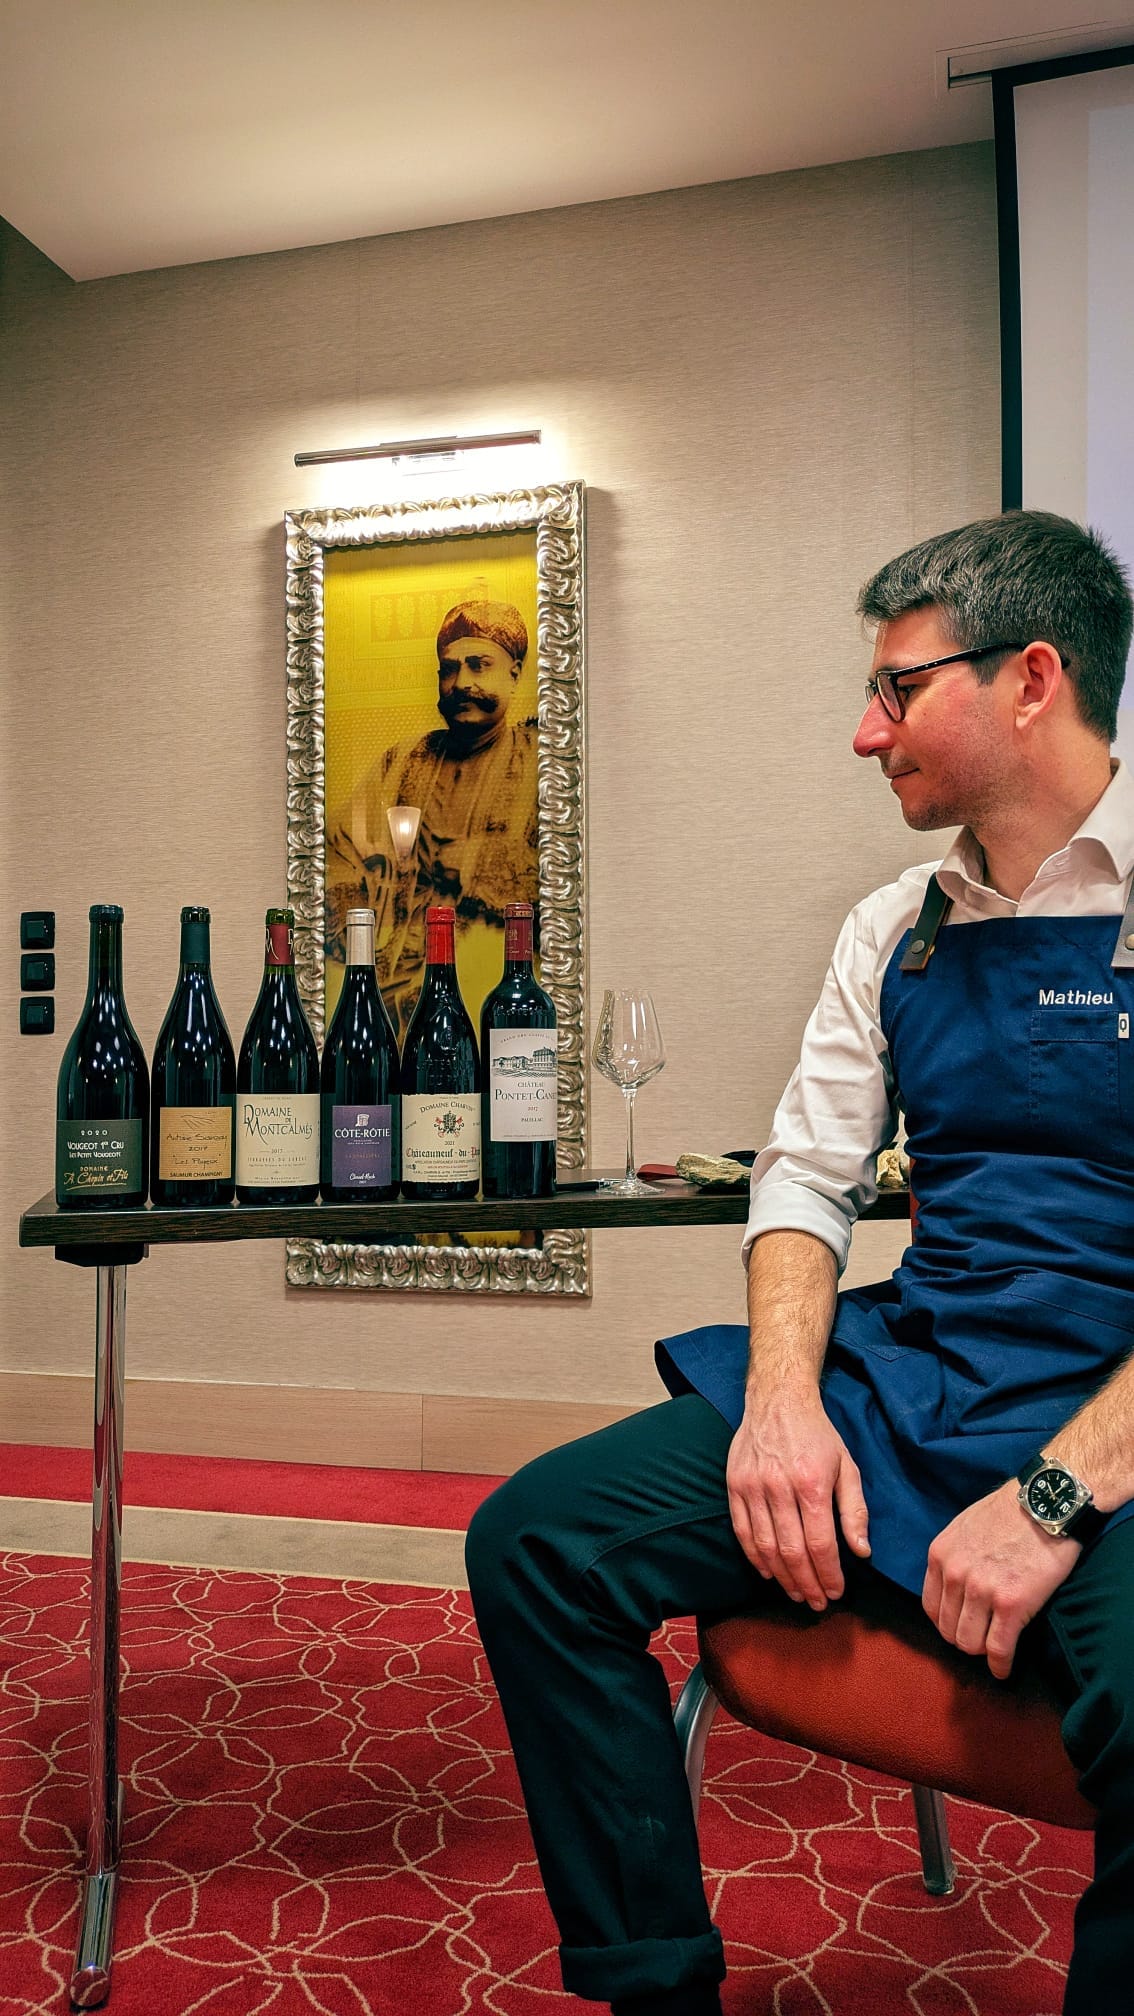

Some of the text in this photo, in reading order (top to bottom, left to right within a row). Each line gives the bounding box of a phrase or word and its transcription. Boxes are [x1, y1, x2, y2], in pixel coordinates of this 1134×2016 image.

[1039, 989, 1113, 1005] Mathieu
[495, 1088, 557, 1101] PONTET-CANE
[420, 1101, 449, 1113] DOMAINE
[243, 1104, 293, 1125] DOMAINE
[334, 1127, 391, 1138] CÔTE-RÔTIE
[110, 1140, 125, 1150] CRU
